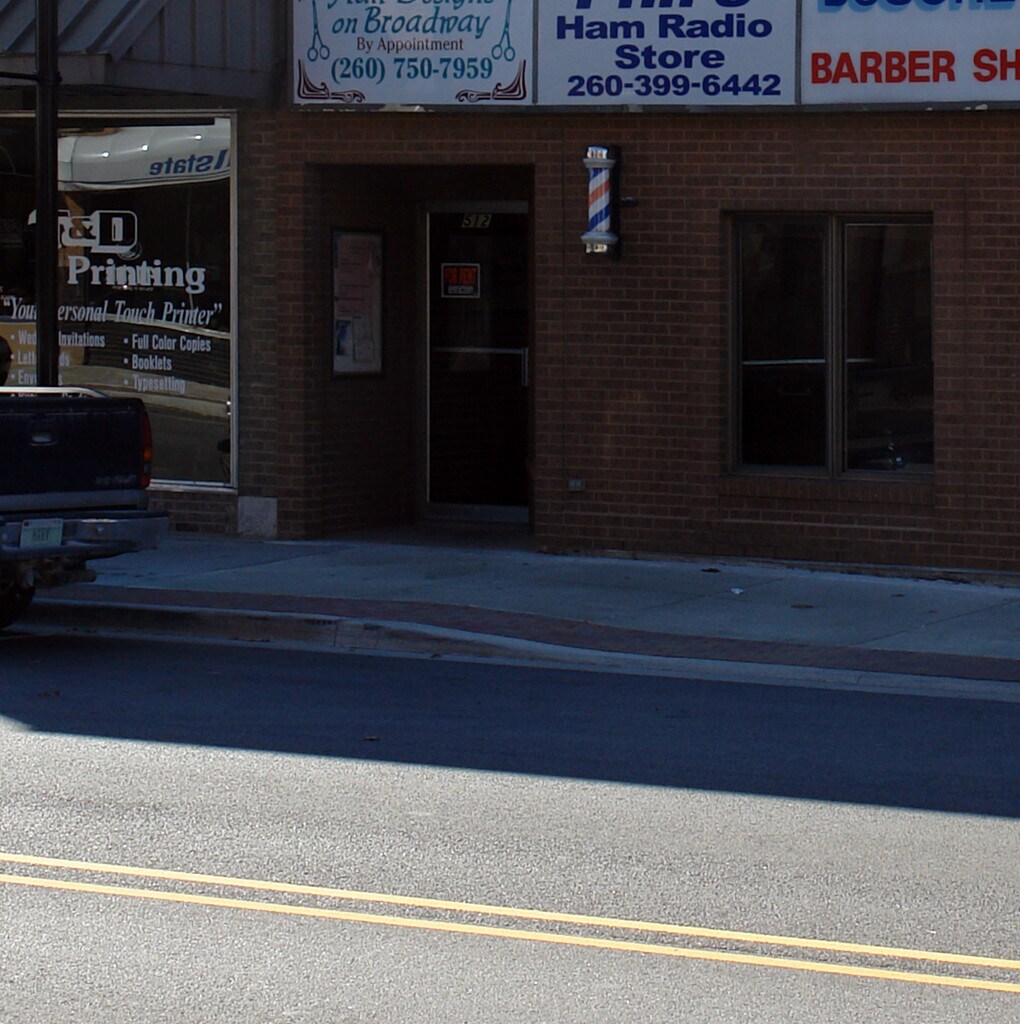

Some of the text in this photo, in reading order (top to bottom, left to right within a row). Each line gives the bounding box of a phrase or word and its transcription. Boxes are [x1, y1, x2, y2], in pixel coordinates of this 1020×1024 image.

[332, 6, 491, 39] on Broadway
[557, 13, 773, 39] Ham Radio
[356, 36, 464, 53] By Appointment
[614, 43, 725, 70] Store
[331, 57, 493, 84] (260) 750-7959
[811, 50, 956, 85] BARBER
[567, 73, 782, 97] 260-399-6442
[463, 214, 490, 228] 512
[67, 255, 206, 295] Printing
[57, 299, 108, 323] ersonal
[114, 299, 155, 324] Touch
[58, 330, 211, 353] Invitations Full Color Copies
[132, 354, 172, 371] Booklets
[133, 375, 186, 395] Typesetting
